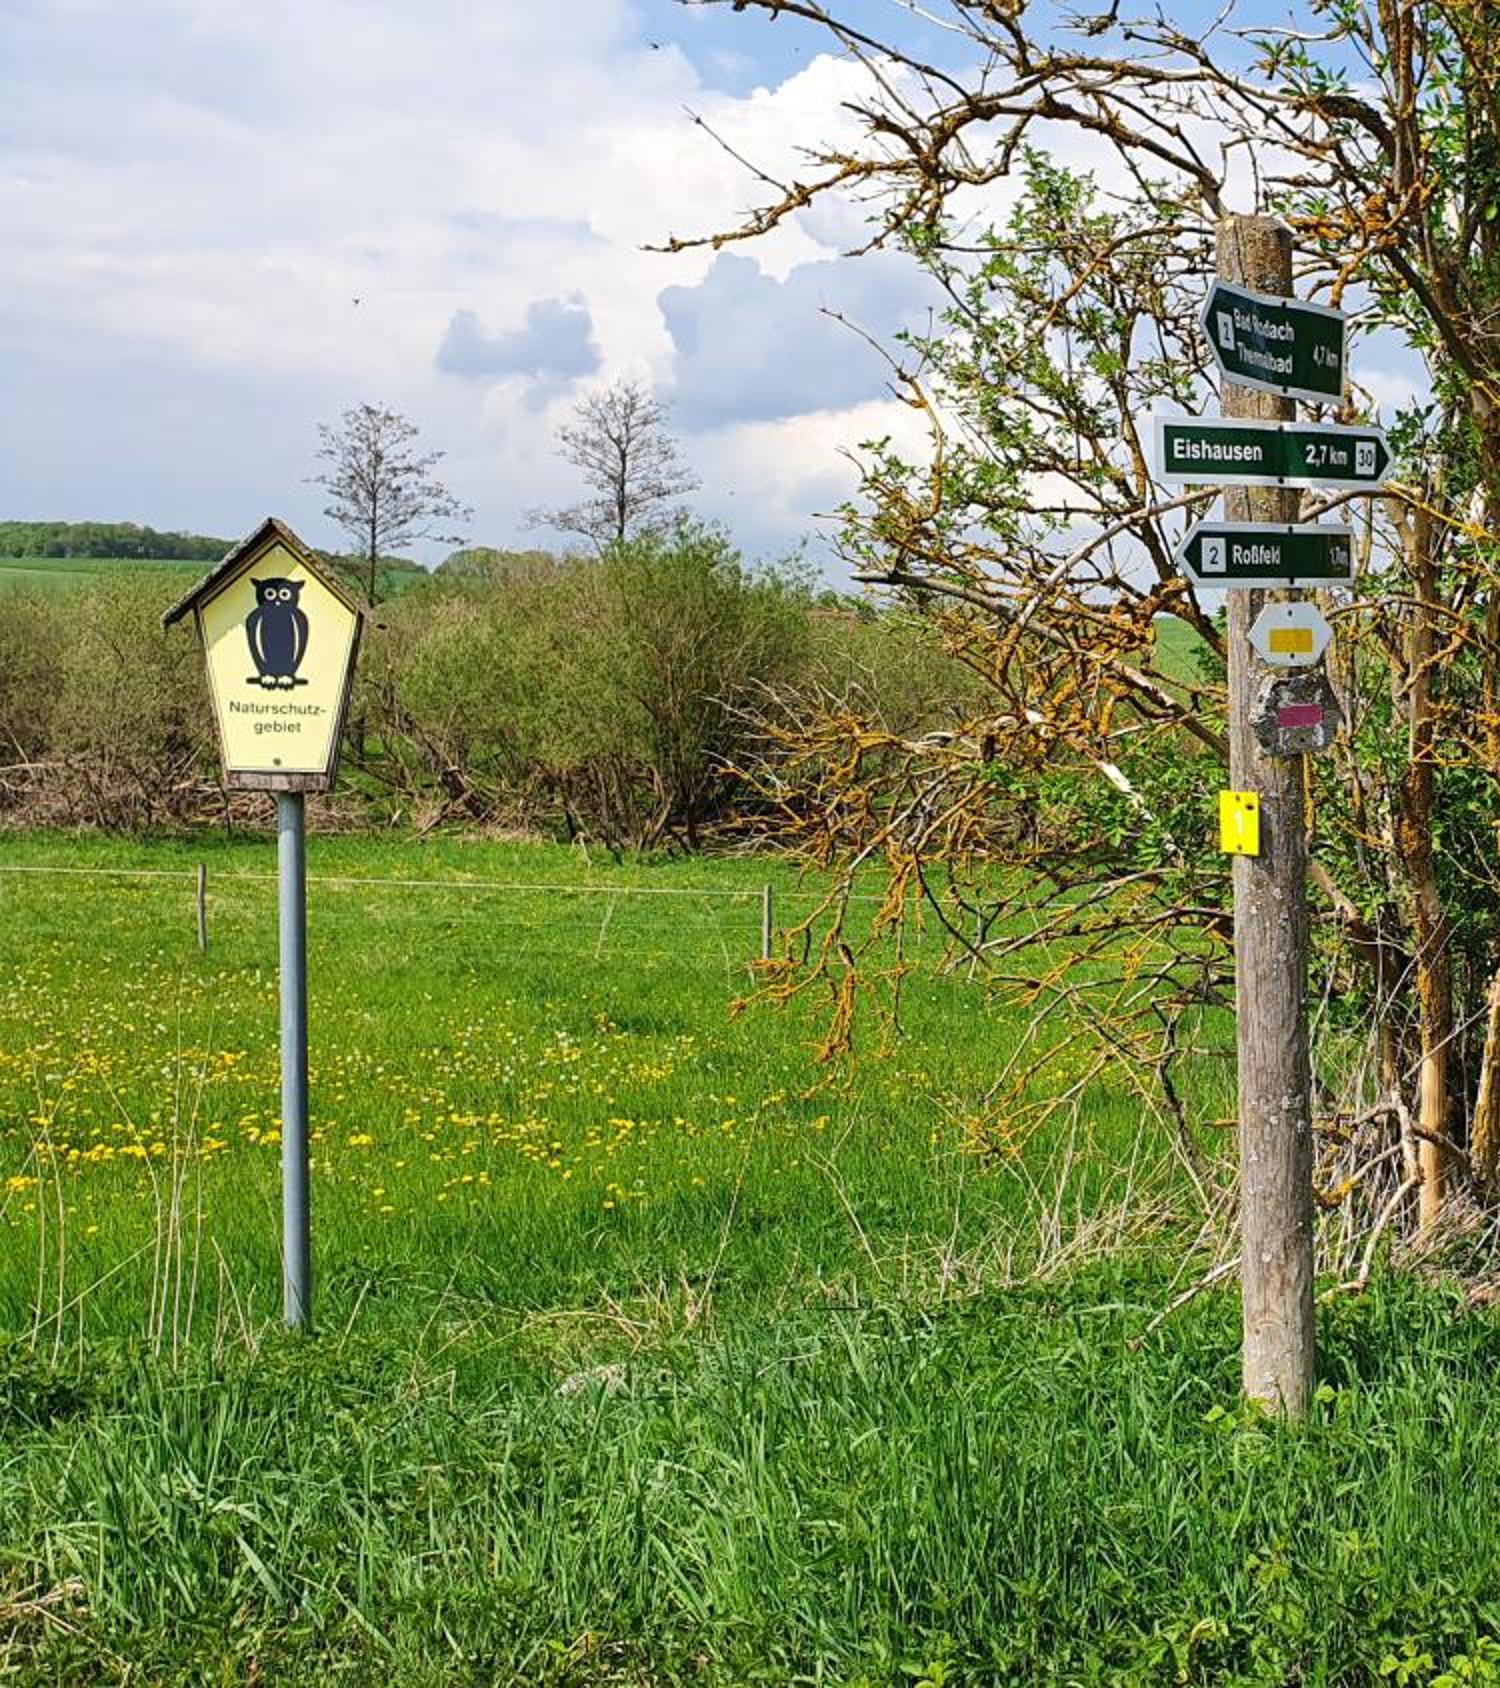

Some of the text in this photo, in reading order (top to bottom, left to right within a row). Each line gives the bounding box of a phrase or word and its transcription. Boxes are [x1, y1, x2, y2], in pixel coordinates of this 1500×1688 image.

[1233, 308, 1295, 341] Bad Rodach
[1326, 347, 1338, 368] km
[1173, 438, 1348, 467] Eishausen 2,7 km
[1358, 449, 1374, 467] 30
[1209, 547, 1219, 565] 2
[1232, 544, 1281, 565] Roßfeld
[230, 701, 328, 715] Naturschutz-
[253, 721, 301, 735] gebiet
